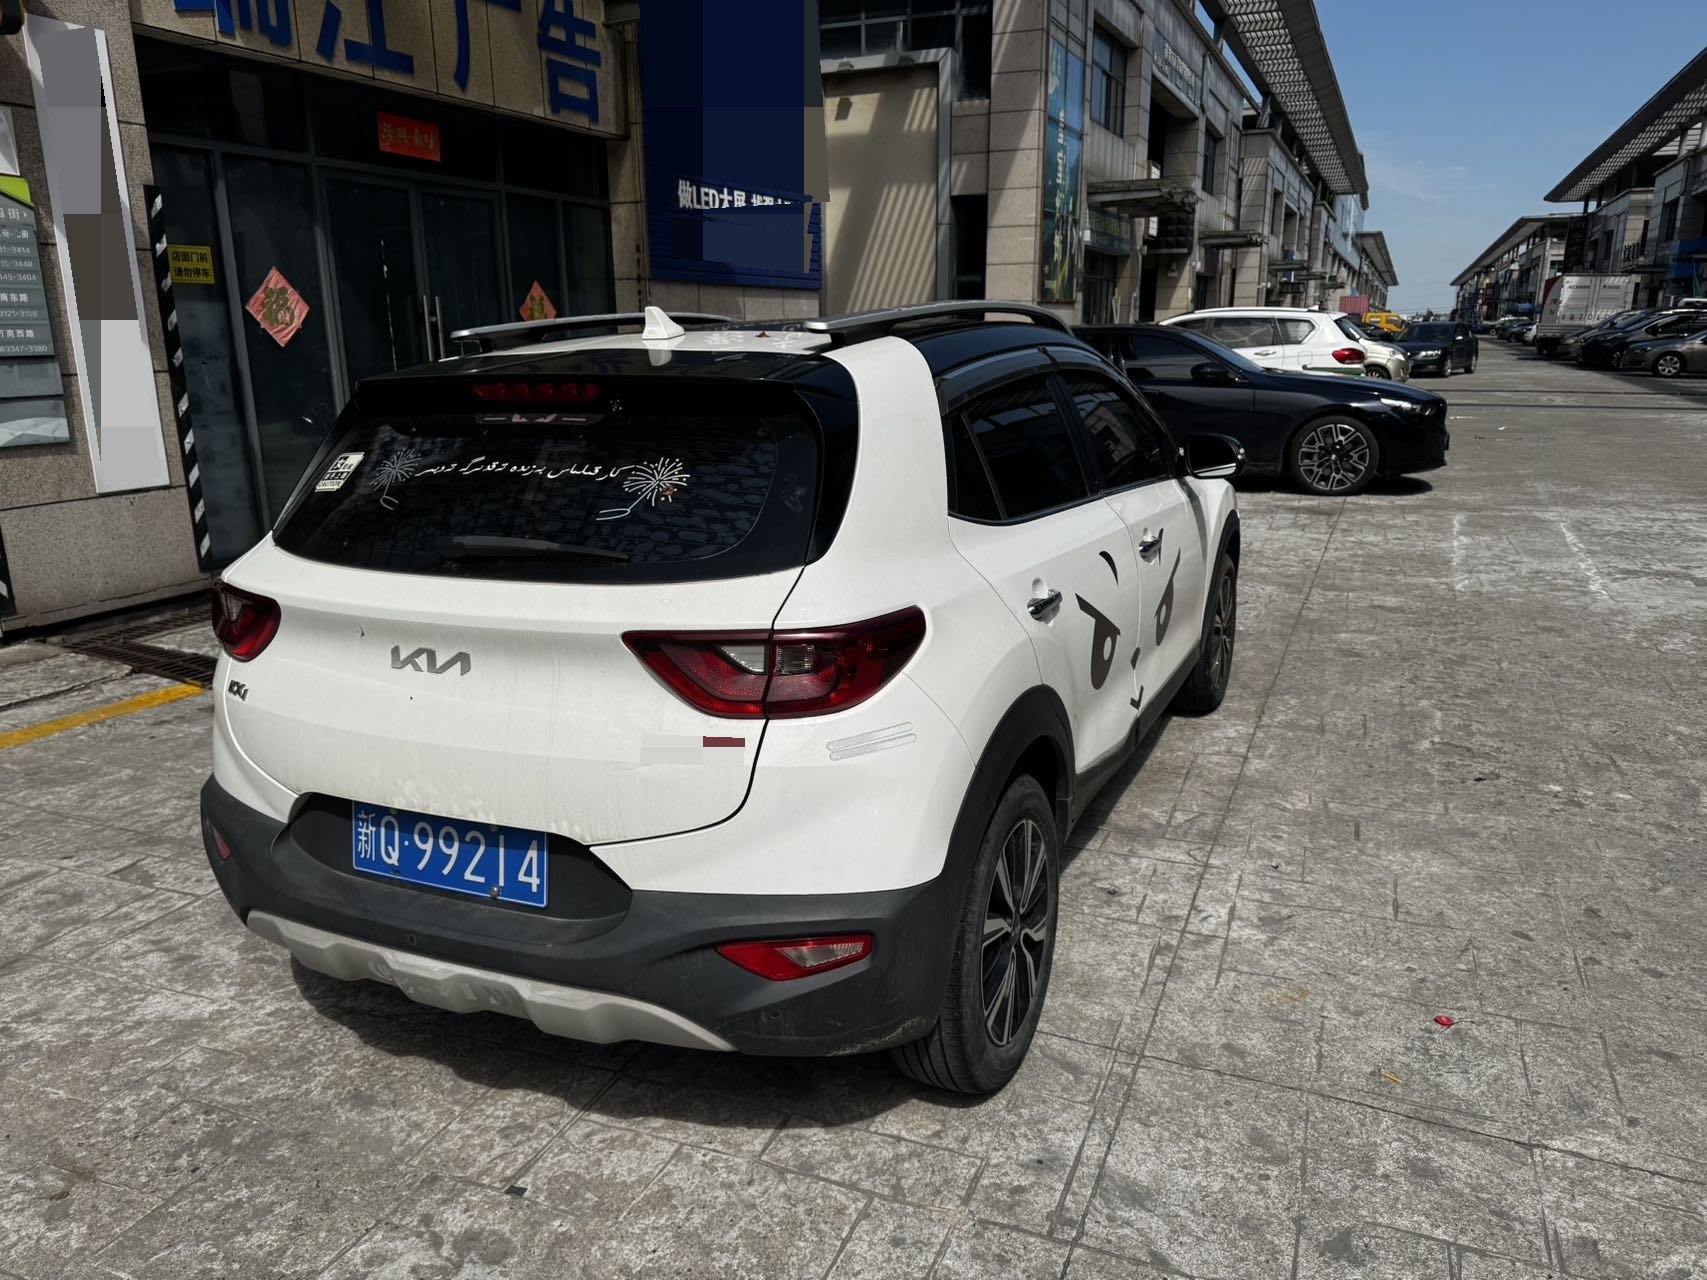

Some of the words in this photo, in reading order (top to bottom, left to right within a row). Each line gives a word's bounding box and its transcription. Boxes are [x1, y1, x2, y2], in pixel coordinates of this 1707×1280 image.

[172, 251, 208, 263] 店面门前
[174, 267, 210, 278] 请勿停车
[391, 645, 472, 676] KIA
